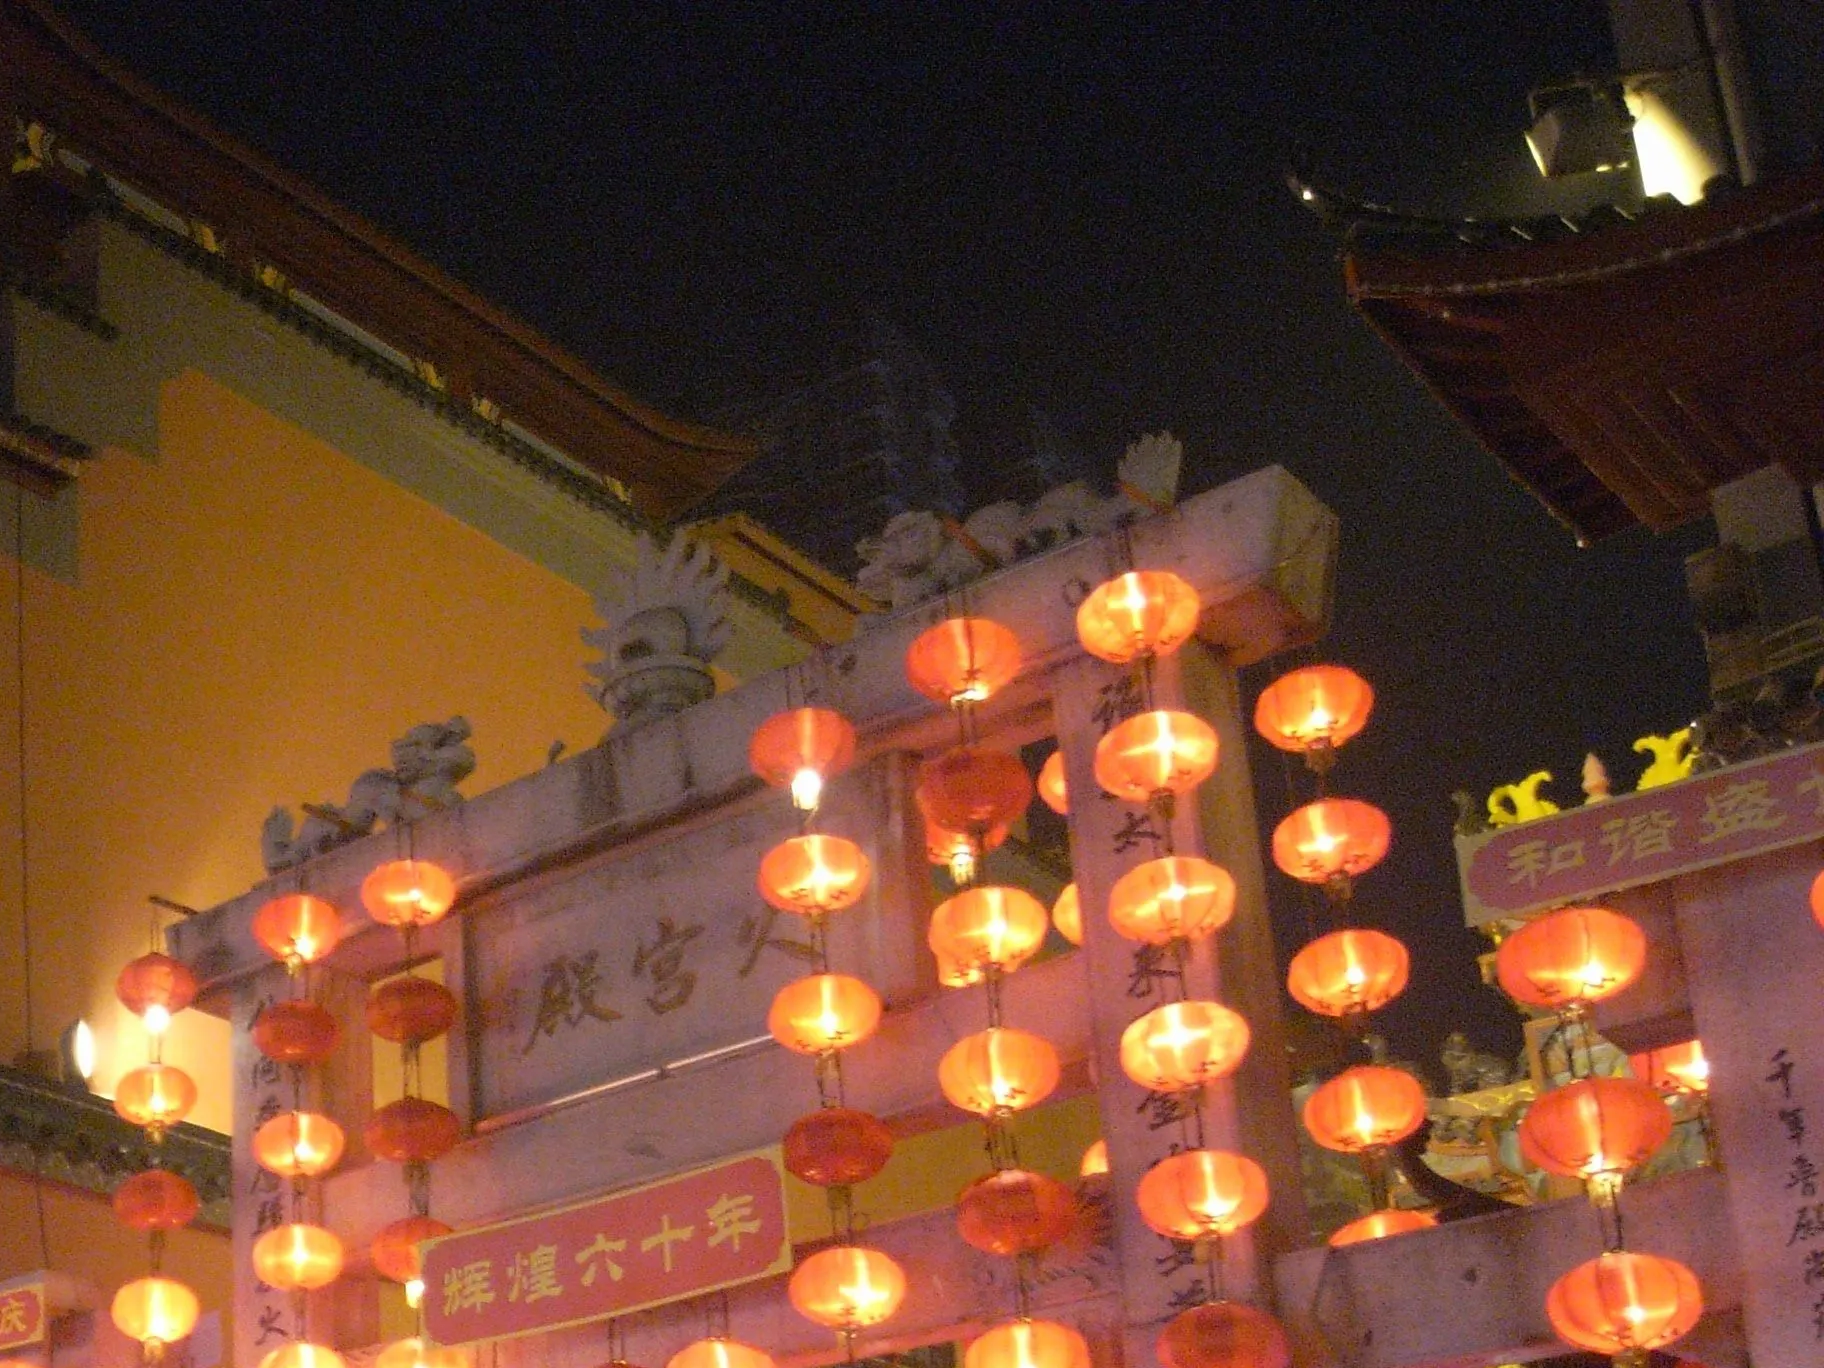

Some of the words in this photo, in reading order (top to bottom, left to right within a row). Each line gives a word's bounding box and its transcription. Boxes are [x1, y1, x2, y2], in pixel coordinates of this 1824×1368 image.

[441, 1194, 762, 1317] 辉煌六十年
